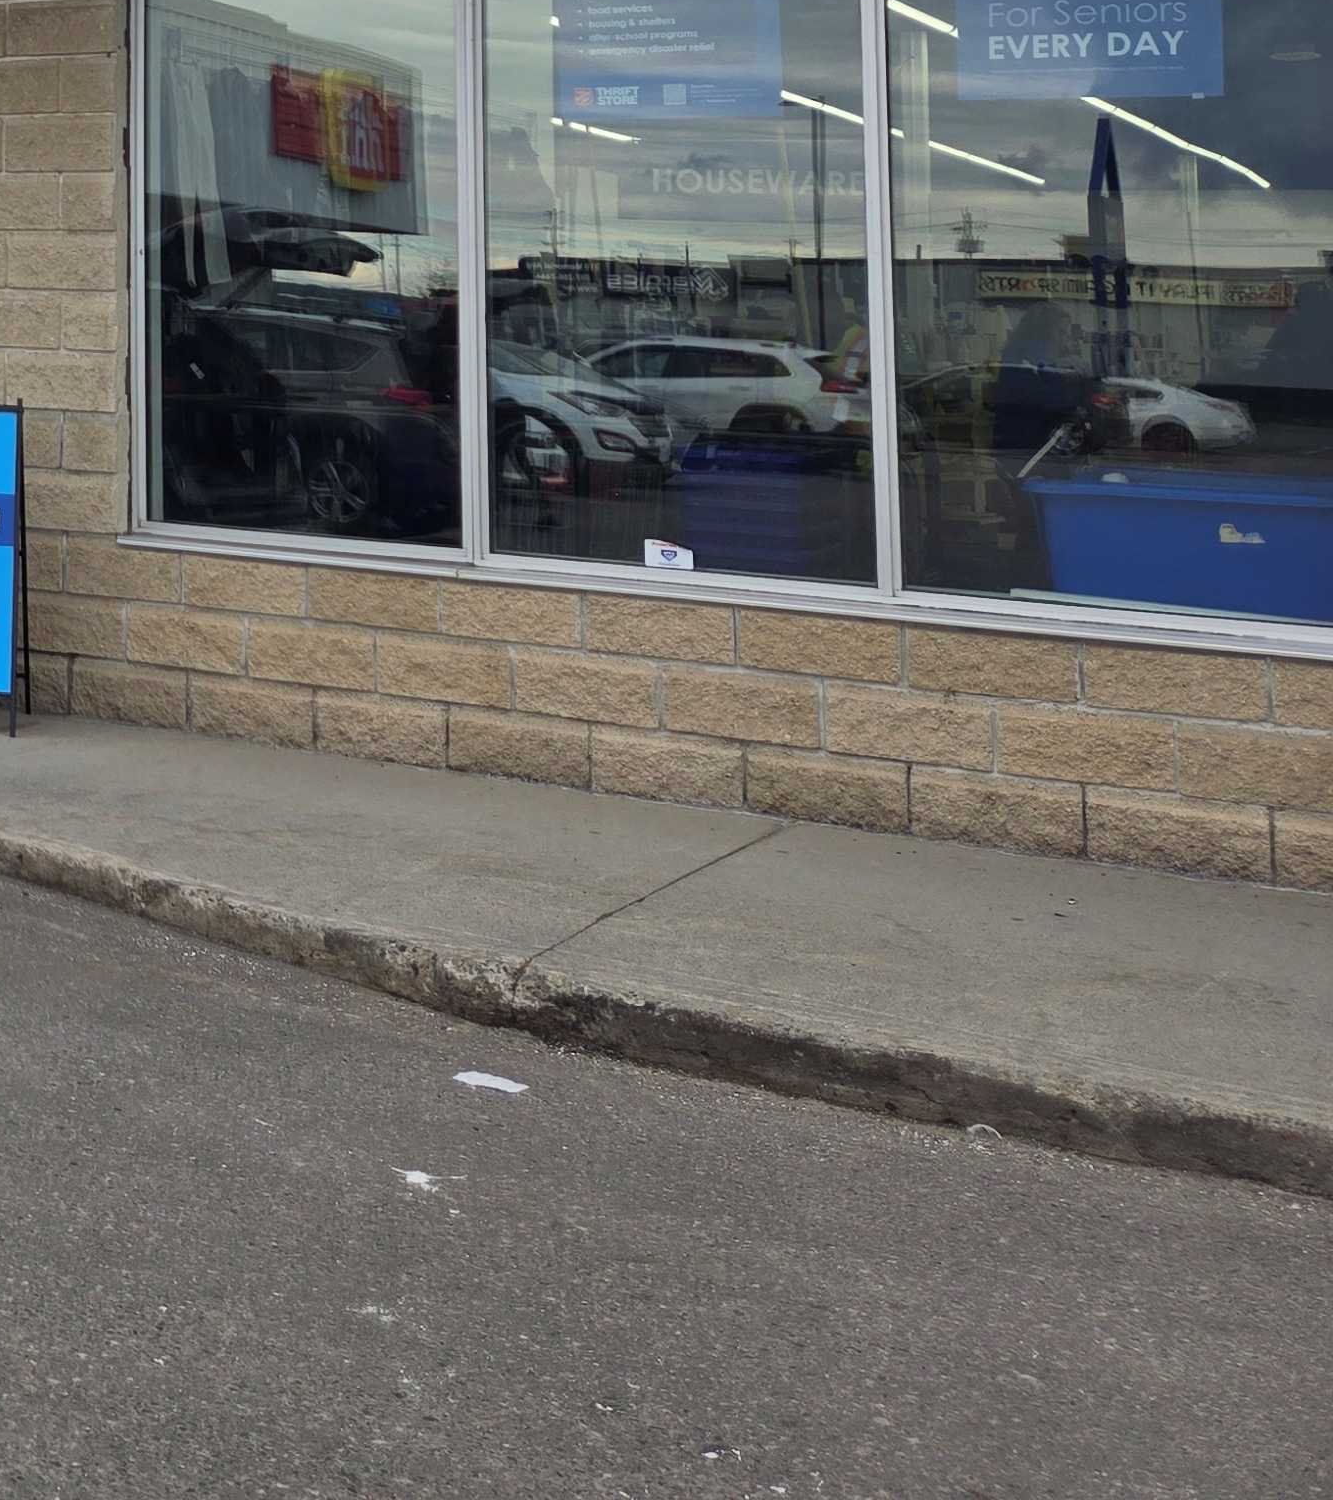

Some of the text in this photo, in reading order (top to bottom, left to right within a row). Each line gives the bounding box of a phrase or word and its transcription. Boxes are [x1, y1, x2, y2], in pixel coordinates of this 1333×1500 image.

[988, 2, 1043, 28] For
[988, 32, 1094, 60] EVERY
[596, 85, 640, 97] THRIFT
[597, 95, 638, 106] STORE
